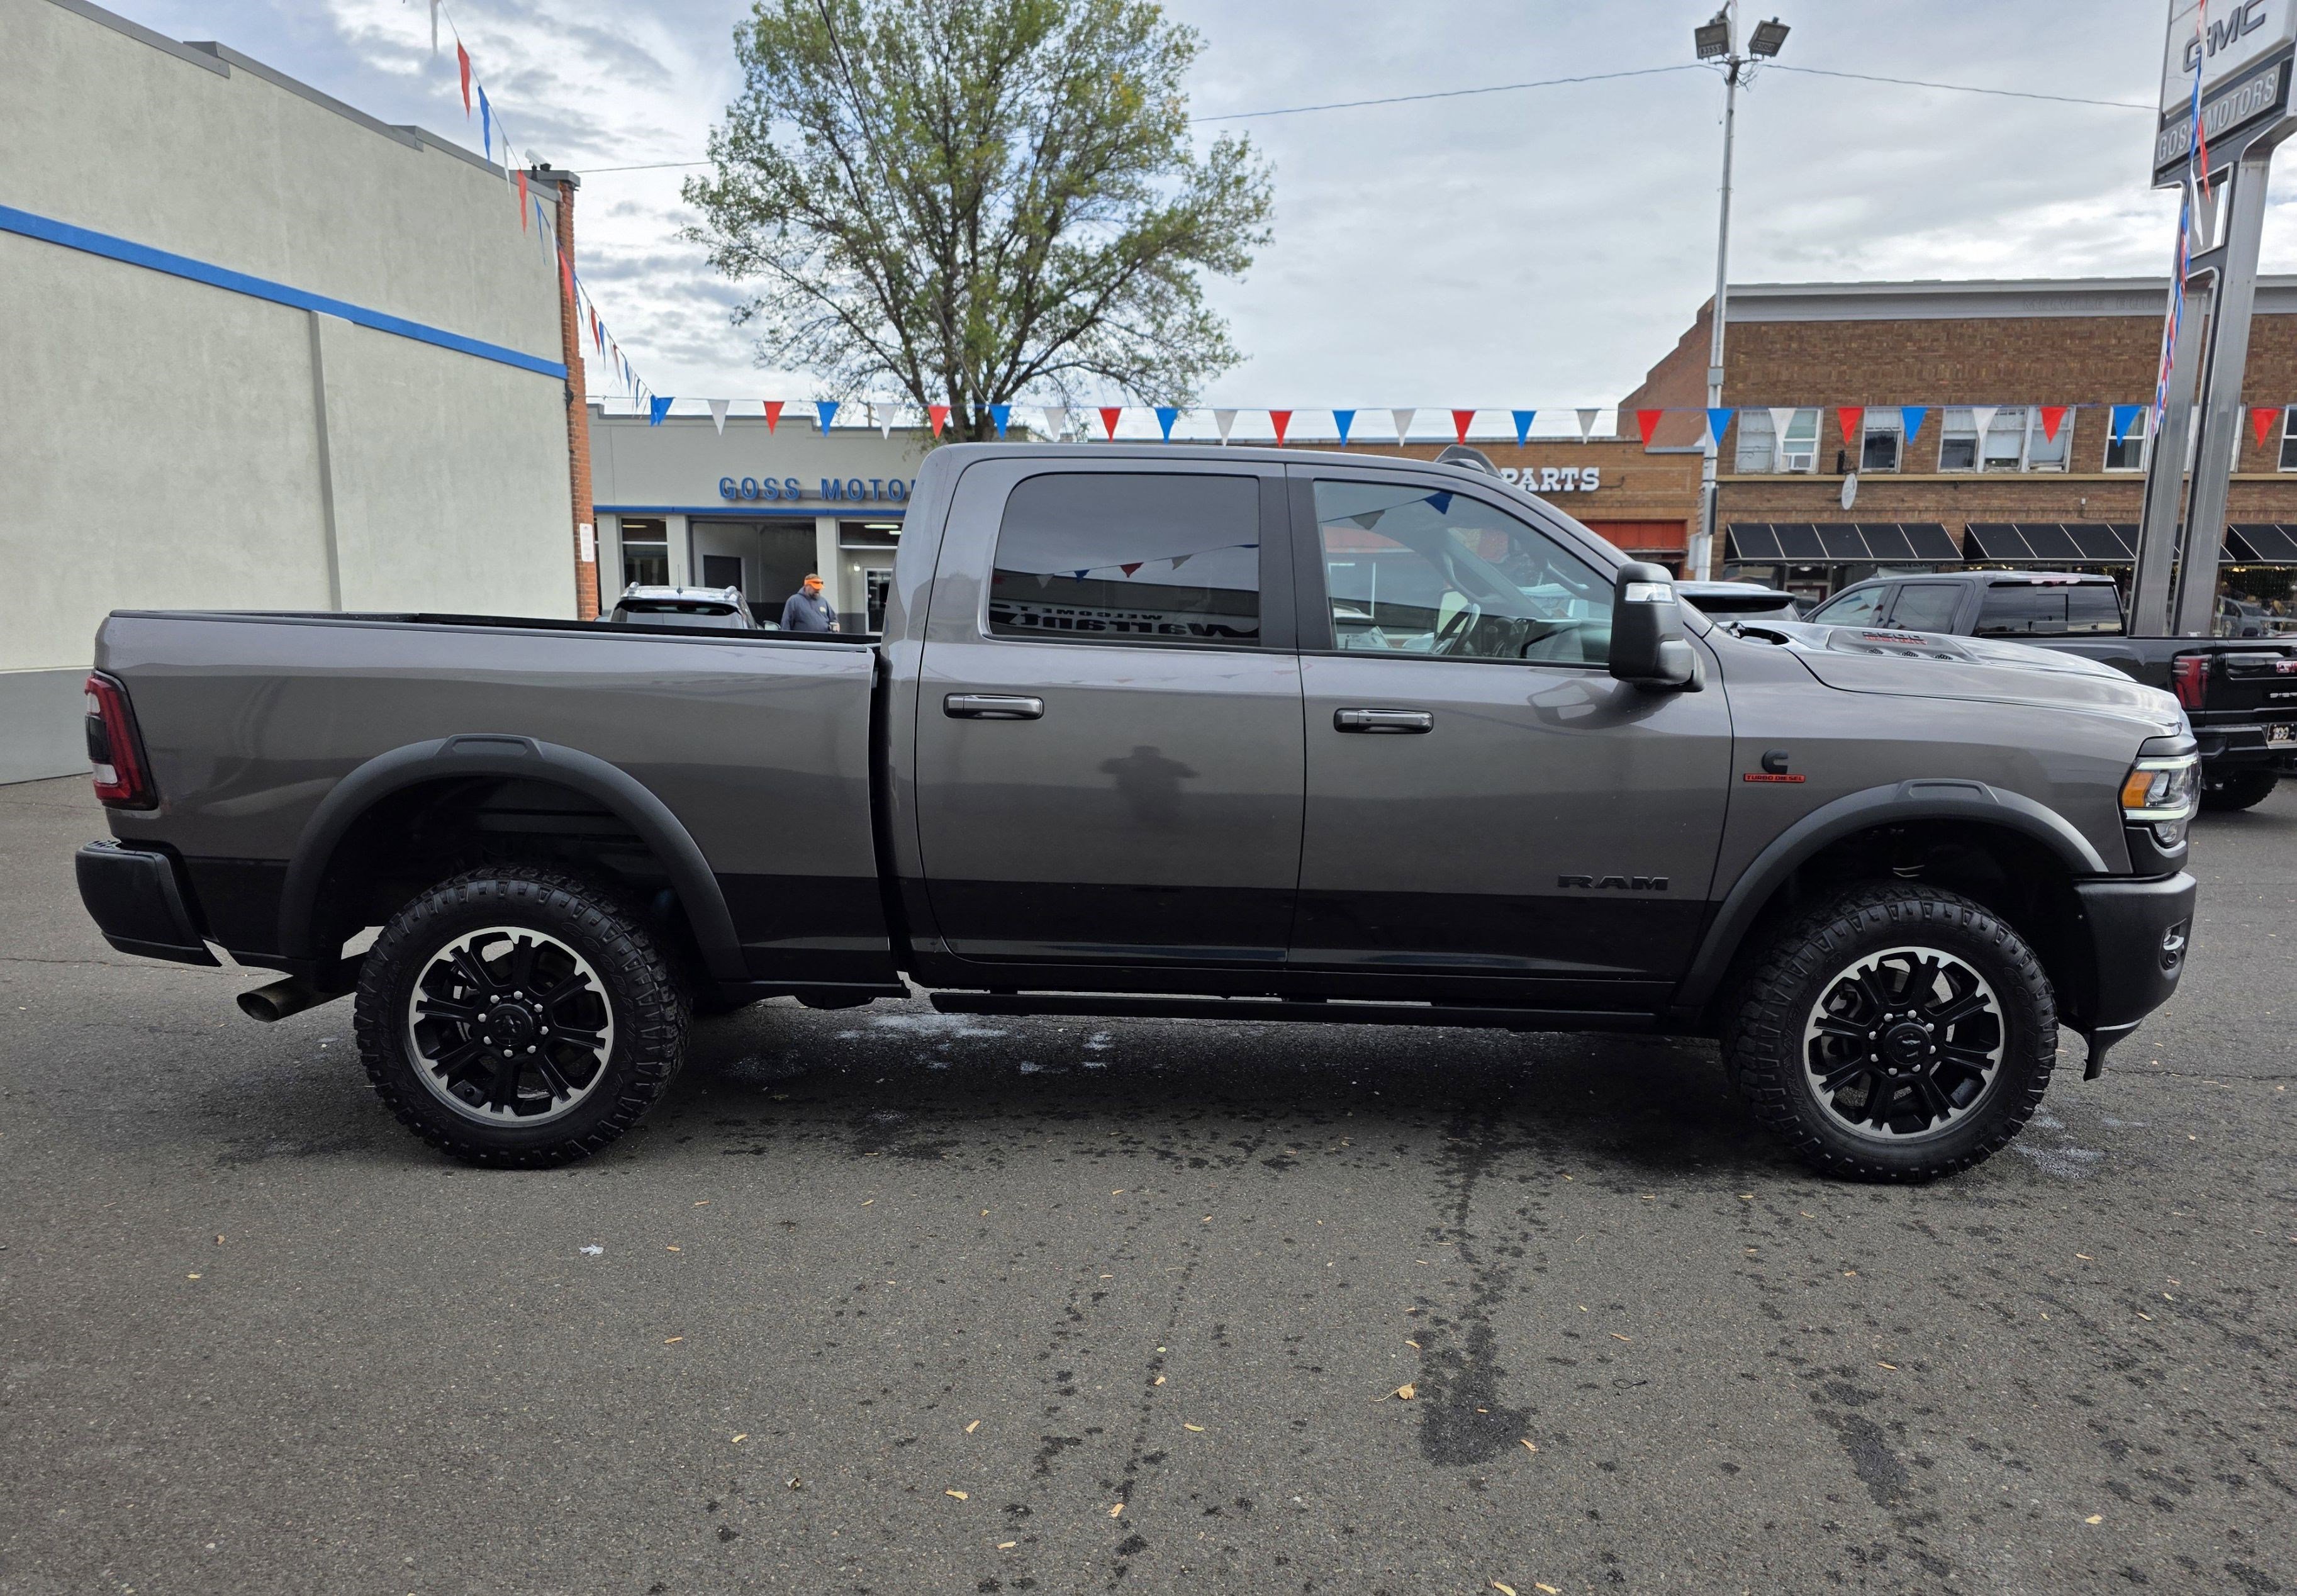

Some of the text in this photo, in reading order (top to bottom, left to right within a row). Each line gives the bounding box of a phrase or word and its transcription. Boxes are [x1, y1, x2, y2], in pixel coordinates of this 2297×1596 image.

[2182, 0, 2266, 73] GMC
[2158, 72, 2277, 162] GOS MOTORS
[719, 476, 917, 501] GOSS MOTO
[1500, 466, 1600, 492] PARTS
[1557, 874, 1669, 891] RAM
